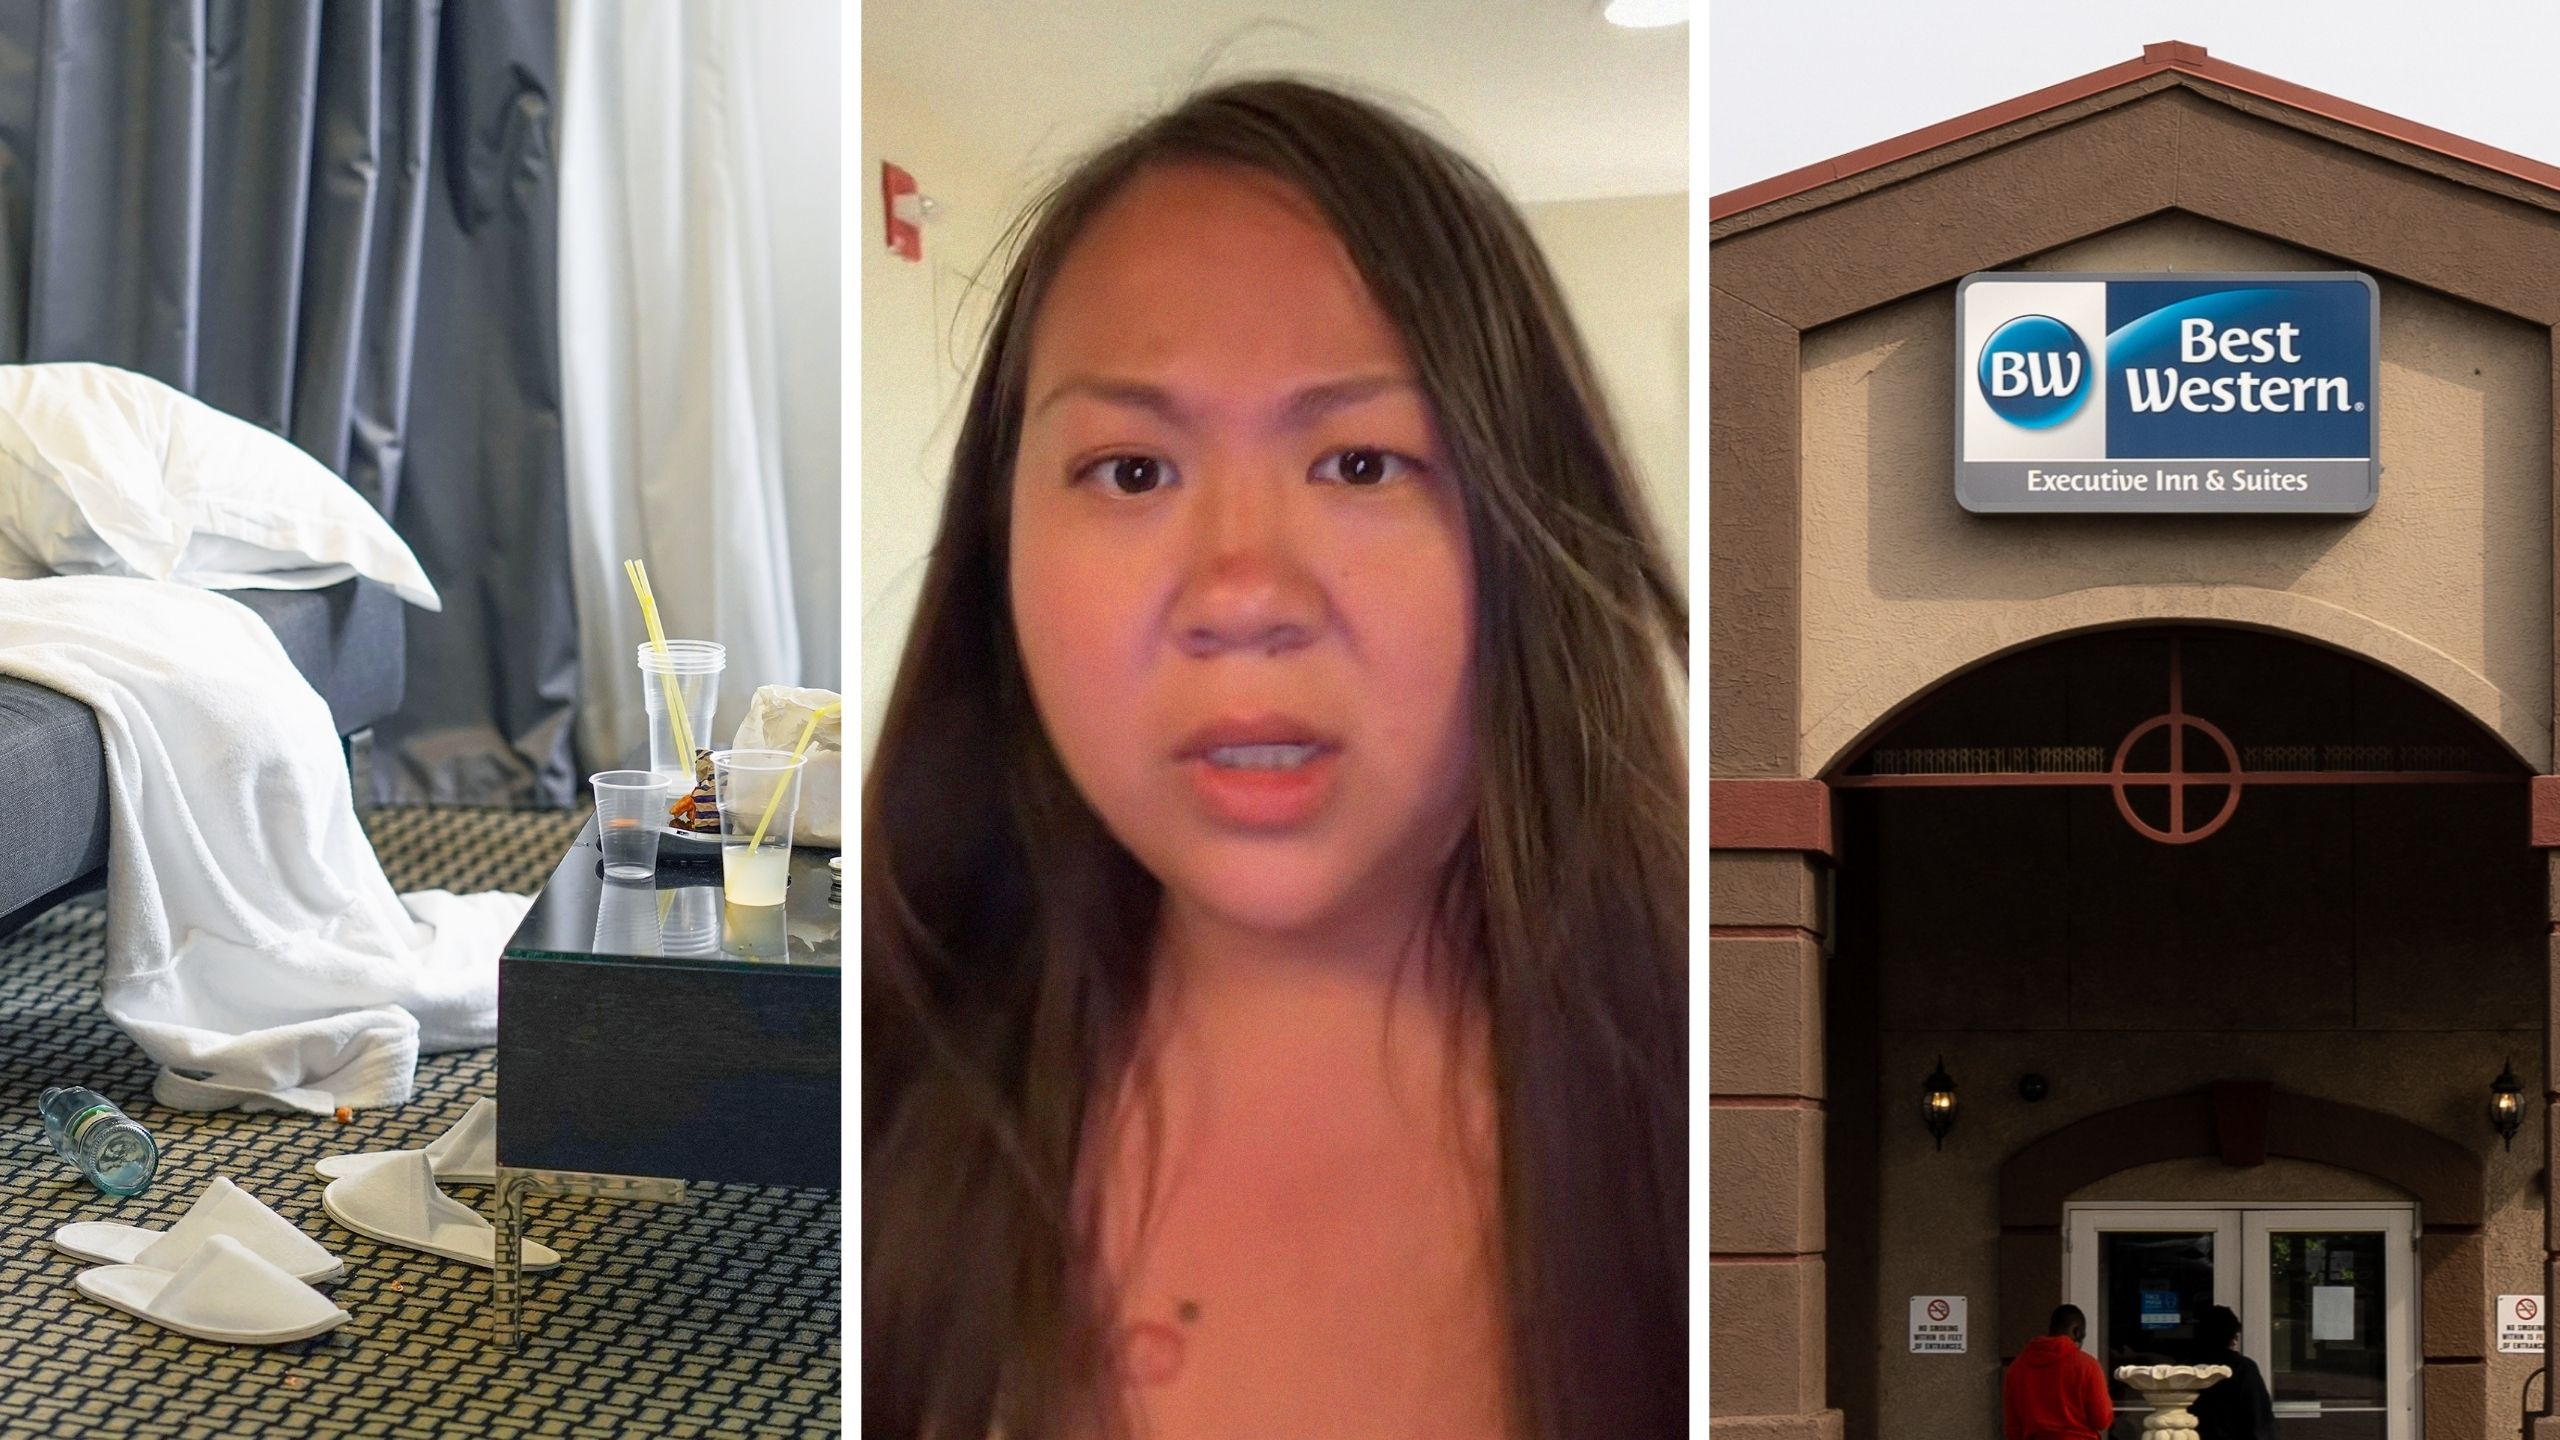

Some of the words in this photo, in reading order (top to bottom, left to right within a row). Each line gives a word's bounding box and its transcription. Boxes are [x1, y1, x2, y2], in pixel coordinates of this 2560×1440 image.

[2180, 318, 2301, 363] Best
[1992, 351, 2081, 398] BW
[2027, 469, 2148, 491] Executive
[2156, 470, 2199, 491] Inn
[2205, 470, 2226, 491] &
[2232, 469, 2308, 492] Suites
